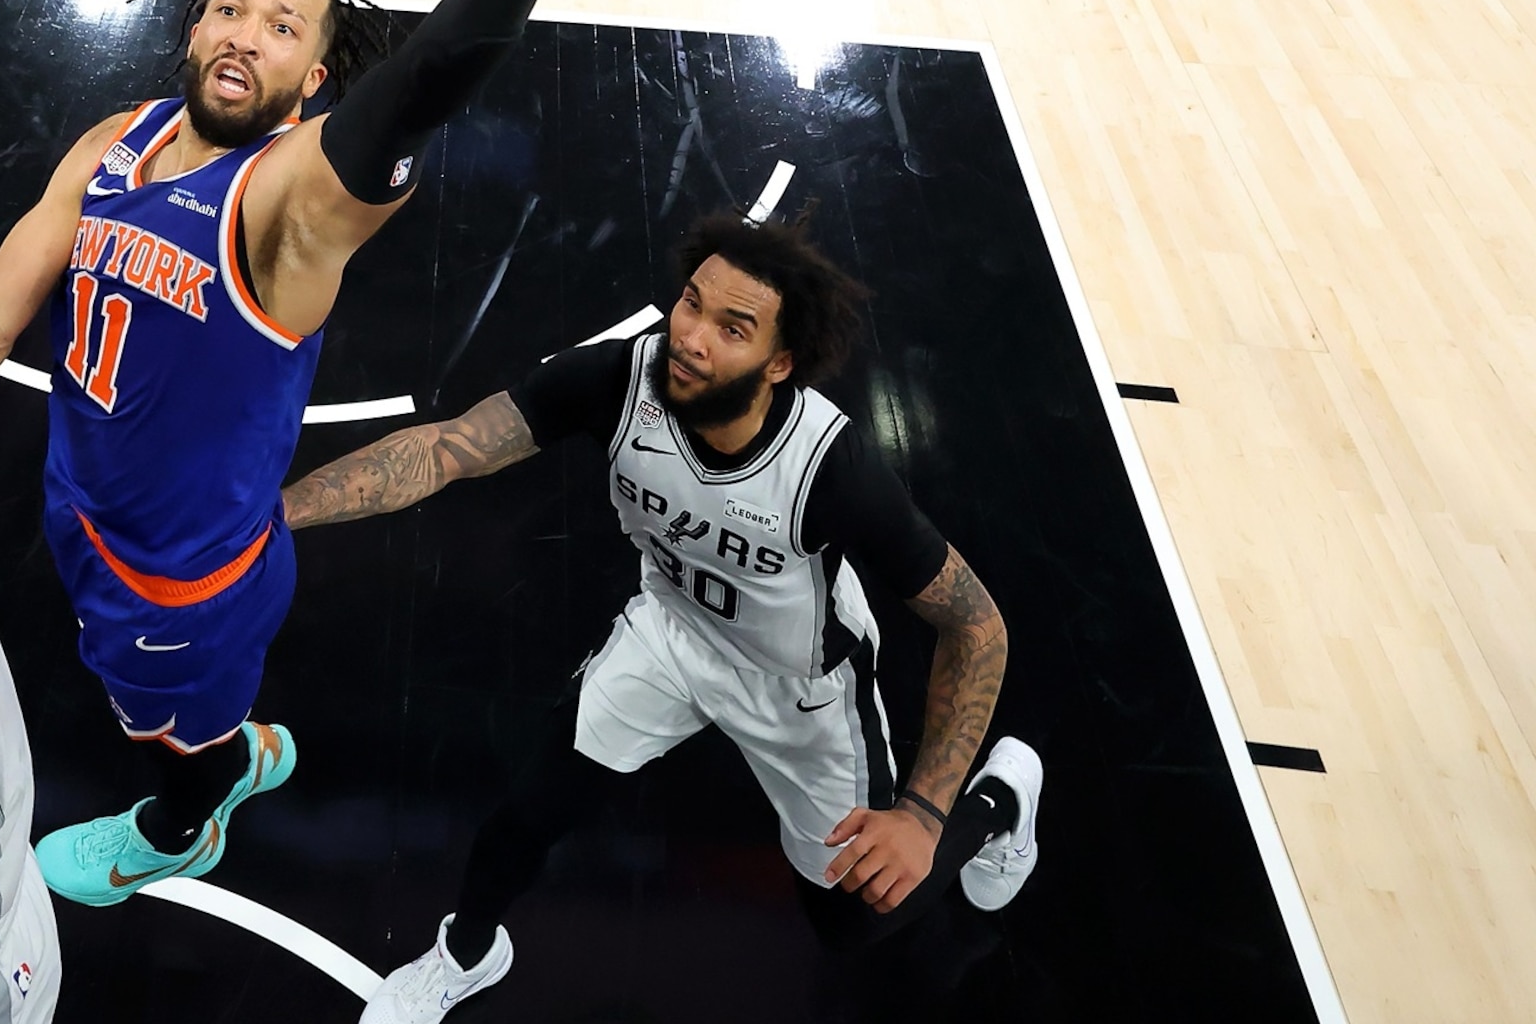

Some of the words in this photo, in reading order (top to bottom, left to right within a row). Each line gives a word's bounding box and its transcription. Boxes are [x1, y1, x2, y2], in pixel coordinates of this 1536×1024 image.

[114, 145, 134, 162] USA
[167, 193, 186, 207] abu
[185, 198, 218, 218] dhabi
[103, 220, 217, 323] YORK
[64, 271, 133, 414] 11
[641, 402, 661, 417] USA
[617, 473, 786, 575] SPURS
[732, 506, 771, 526] LEDGER
[649, 536, 740, 621] 30
